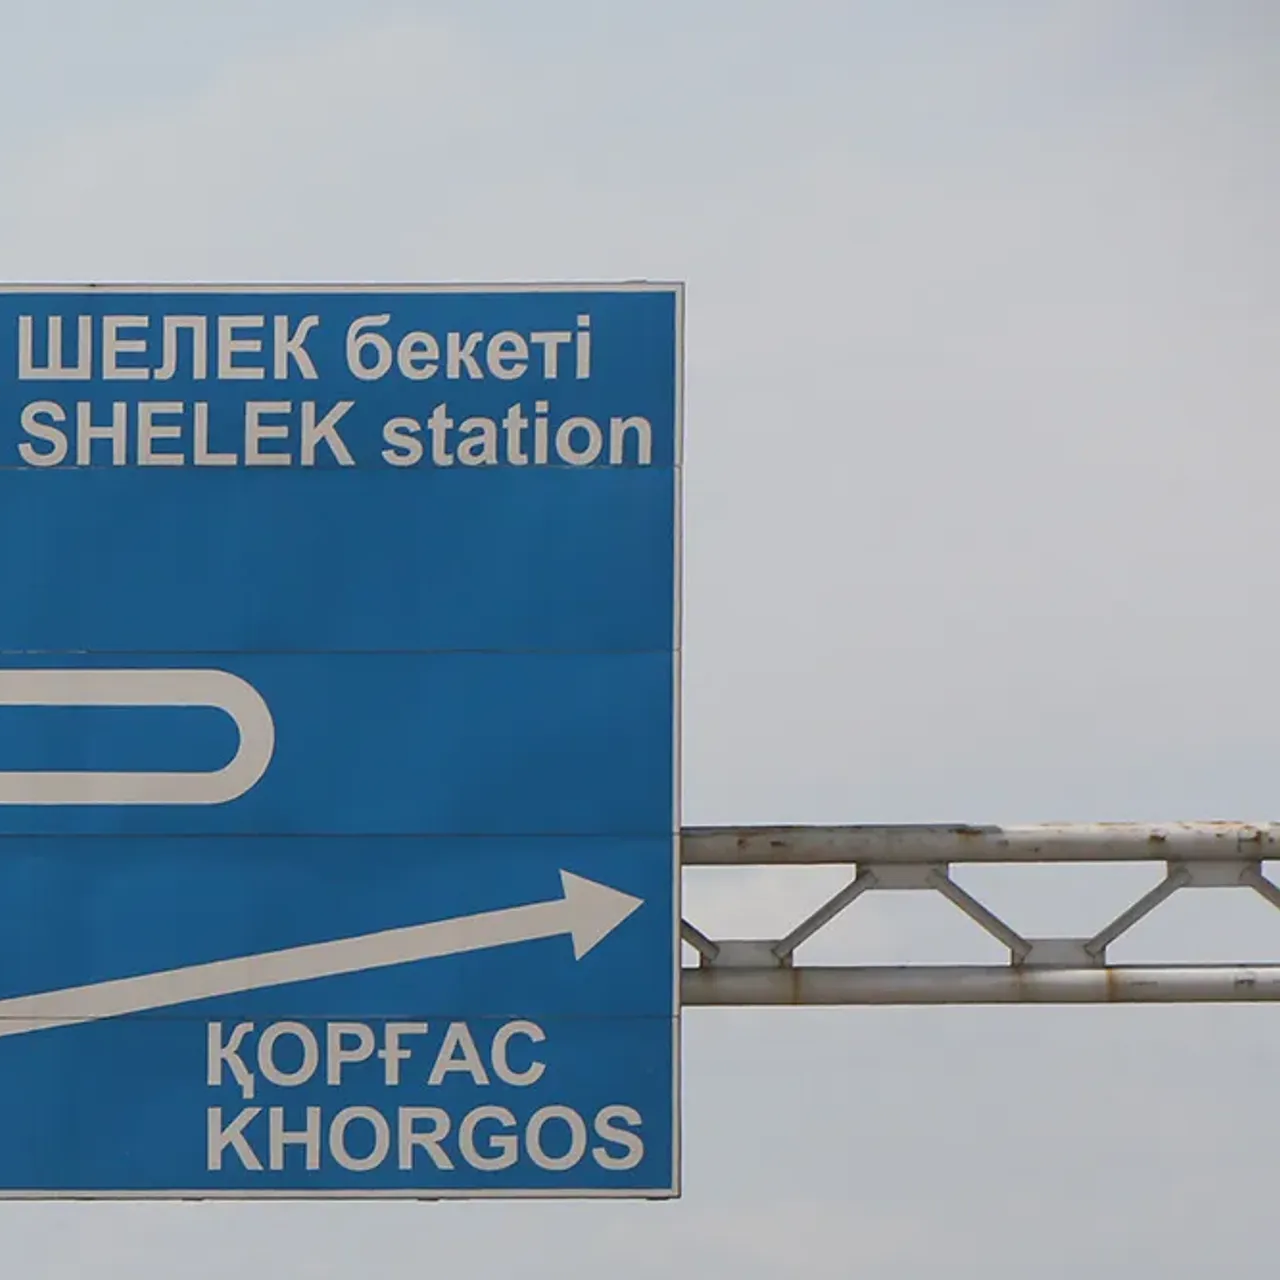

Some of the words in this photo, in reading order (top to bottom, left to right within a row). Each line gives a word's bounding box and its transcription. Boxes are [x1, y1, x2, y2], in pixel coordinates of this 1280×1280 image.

[18, 314, 320, 380] ШЕЛЕК
[346, 313, 591, 380] бекеті
[18, 400, 355, 467] SHELEK
[381, 400, 652, 466] station
[207, 1020, 546, 1098] ҚОРҒАС
[207, 1105, 644, 1171] KHORGOS
